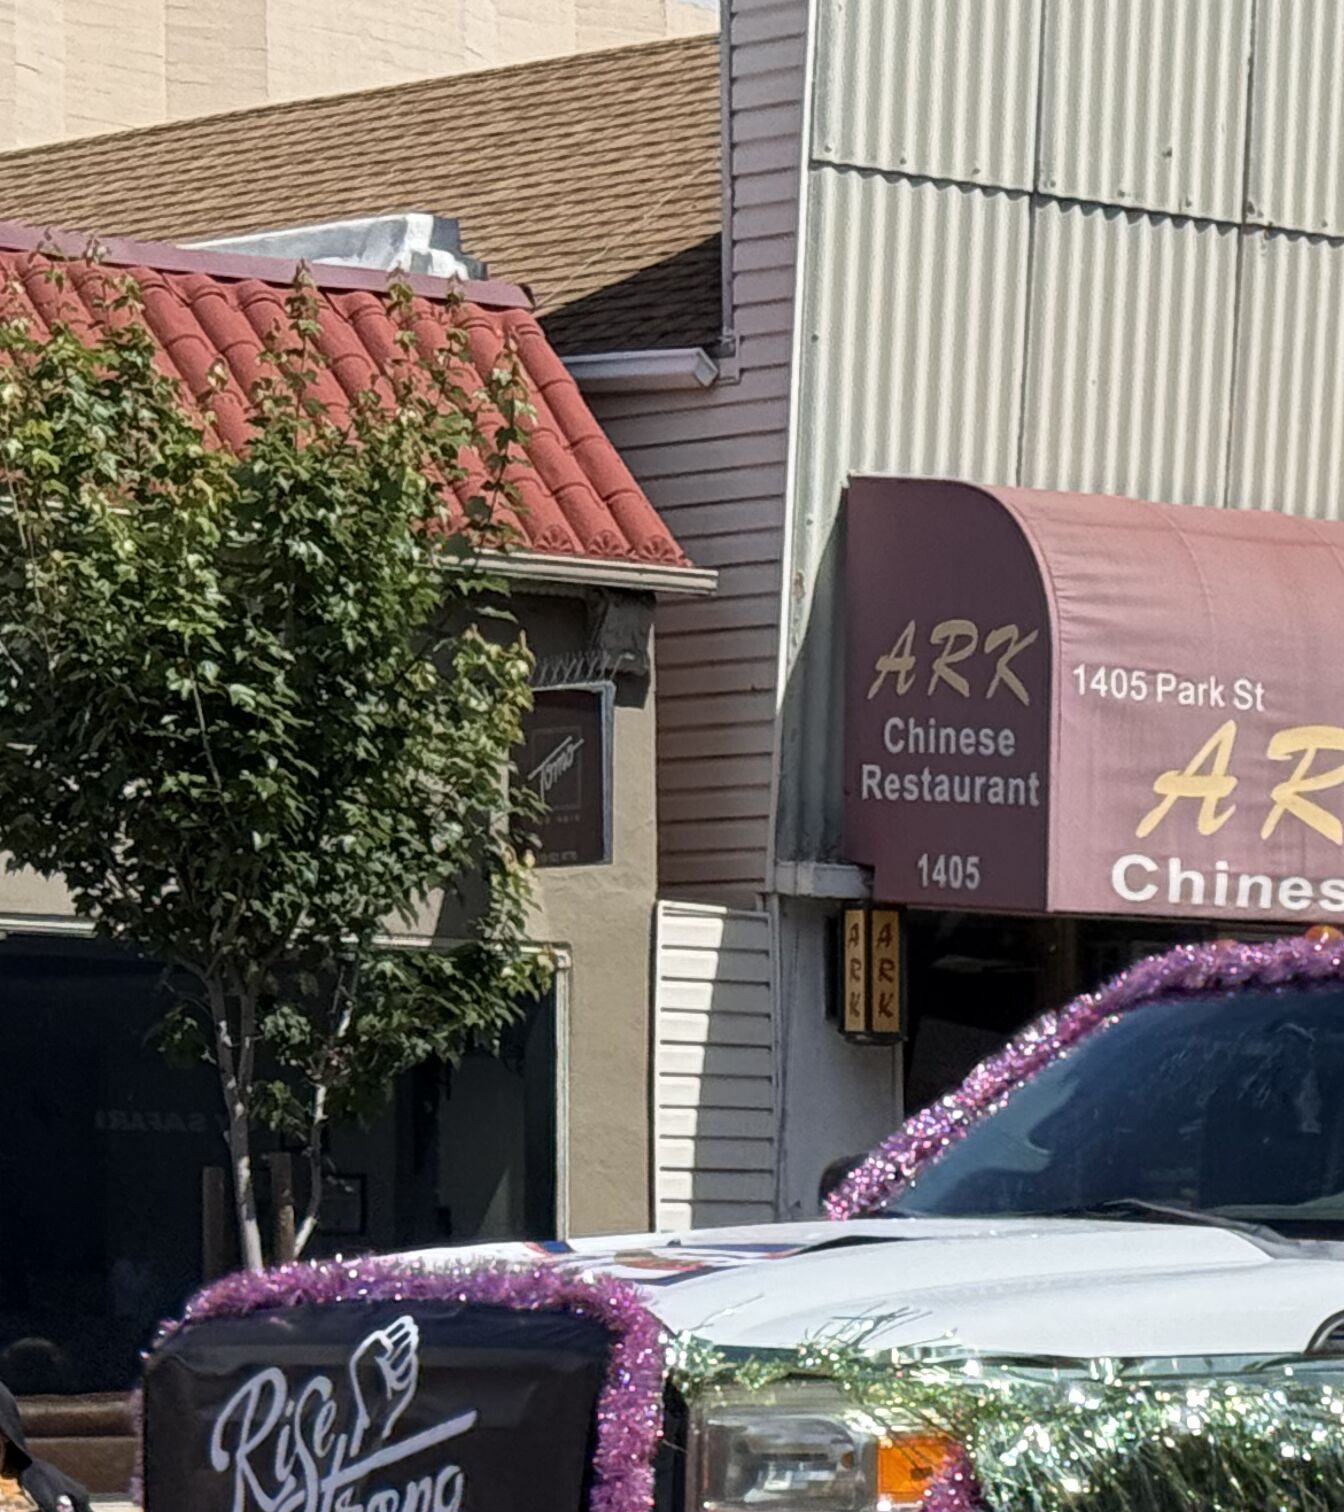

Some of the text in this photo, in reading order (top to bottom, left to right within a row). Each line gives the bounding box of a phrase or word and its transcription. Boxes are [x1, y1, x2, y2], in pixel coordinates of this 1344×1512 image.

[867, 619, 1039, 707] ARK
[1072, 663, 1266, 712] 1405 Park St
[883, 716, 1016, 757] Chinese
[861, 764, 1040, 807] Restaurant
[917, 853, 981, 891] 1405
[876, 922, 897, 1018] ARK
